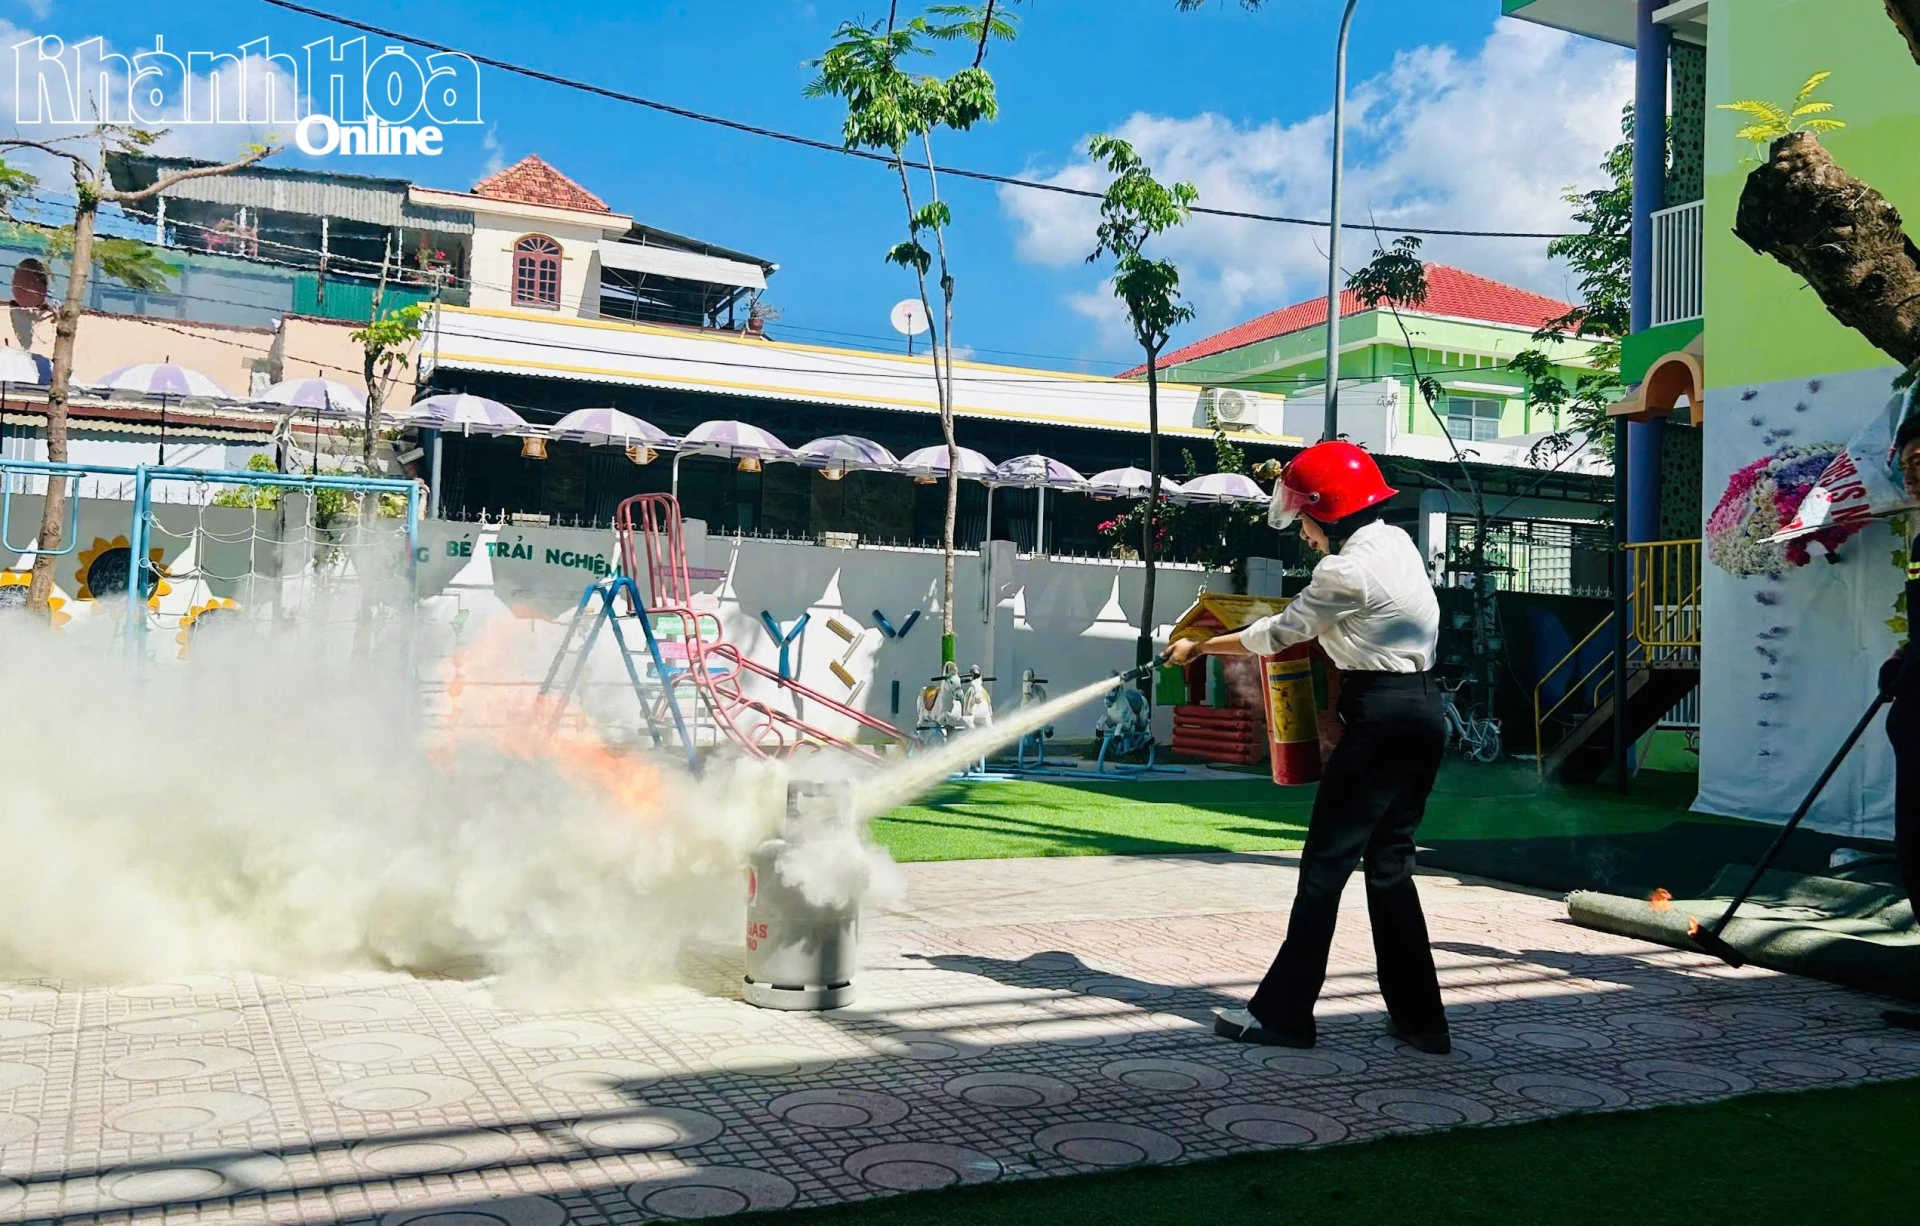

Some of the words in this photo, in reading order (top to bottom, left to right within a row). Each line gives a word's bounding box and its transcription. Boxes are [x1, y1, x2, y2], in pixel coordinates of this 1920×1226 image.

[446, 533, 472, 557] BÉ
[485, 535, 533, 559] TRẢI
[545, 548, 622, 579] NGHIỆM
